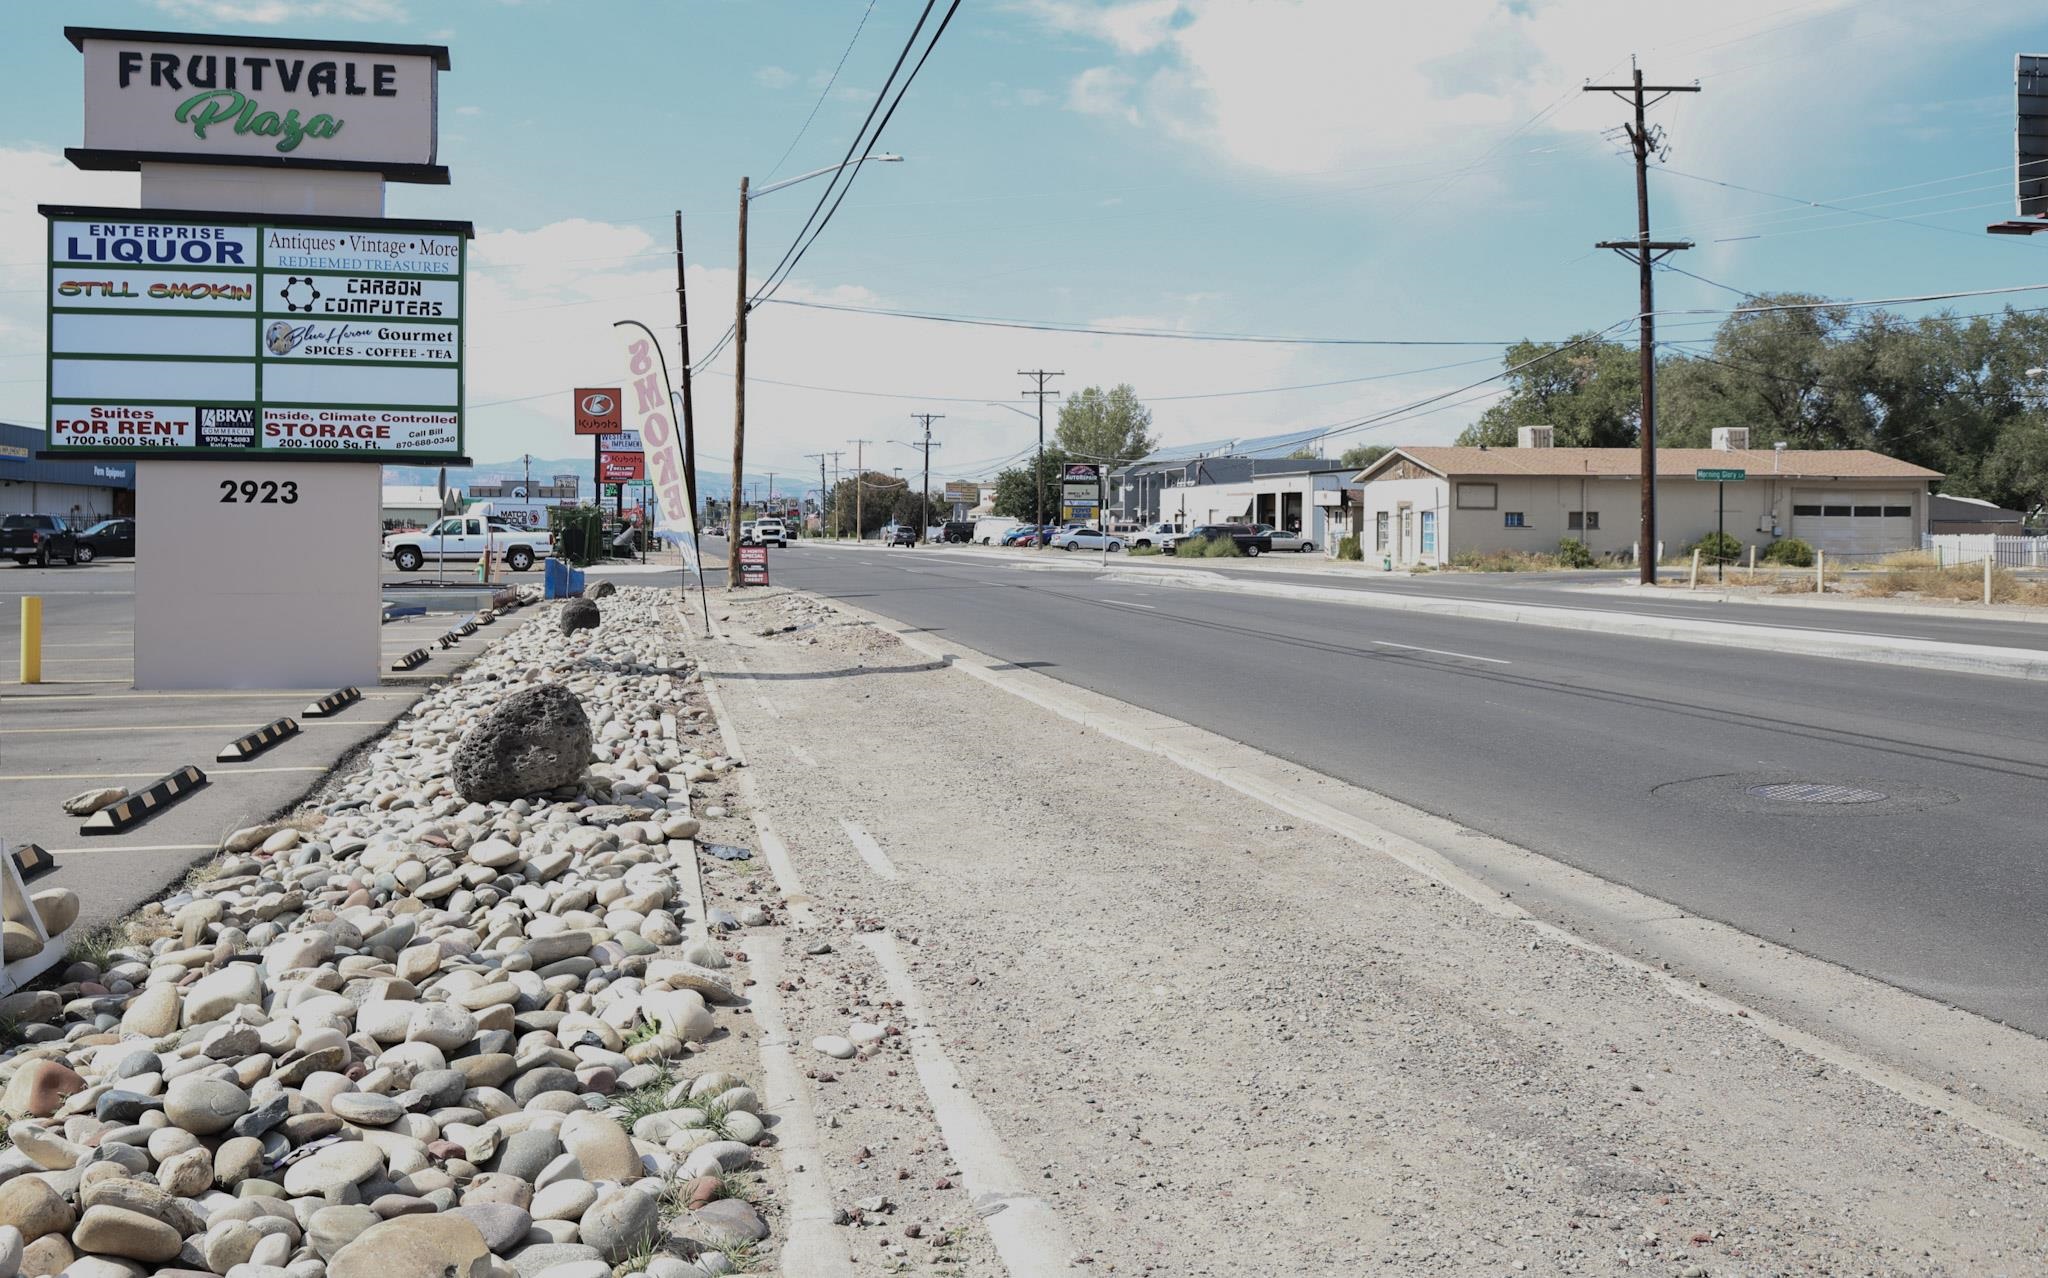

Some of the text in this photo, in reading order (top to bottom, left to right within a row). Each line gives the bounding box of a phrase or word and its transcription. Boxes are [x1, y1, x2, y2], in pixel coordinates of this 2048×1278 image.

[118, 51, 398, 98] FRUITVALE
[174, 88, 345, 153] Plaza
[89, 224, 225, 240] ENTERPRISE
[67, 237, 245, 264] LIQUOR
[268, 232, 459, 259] Antiques Vintage More
[278, 255, 449, 273] REDEEMED TREASURES
[58, 281, 252, 301] STILL SMOKIN
[347, 278, 422, 296] CARBON
[325, 298, 443, 316] COMPUTERS
[283, 324, 453, 349] Blue Heron Gourmet
[304, 345, 452, 359] SPICES COFFEE TEA
[90, 407, 154, 419] Suites
[216, 409, 253, 422] BRAY
[264, 411, 457, 425] Inside, Climate Controlled
[56, 420, 189, 436] FOR RENT
[265, 422, 391, 439] STORAGE
[578, 418, 618, 429] Kubota
[408, 427, 443, 439] Call Bill
[65, 436, 135, 446] 1700-6000
[162, 437, 178, 447] Ft.
[279, 438, 339, 449] 200-1000
[364, 440, 381, 449] Ft.
[611, 455, 643, 463] Kubota
[219, 480, 299, 504] 2923
[500, 510, 528, 518] MATCO
